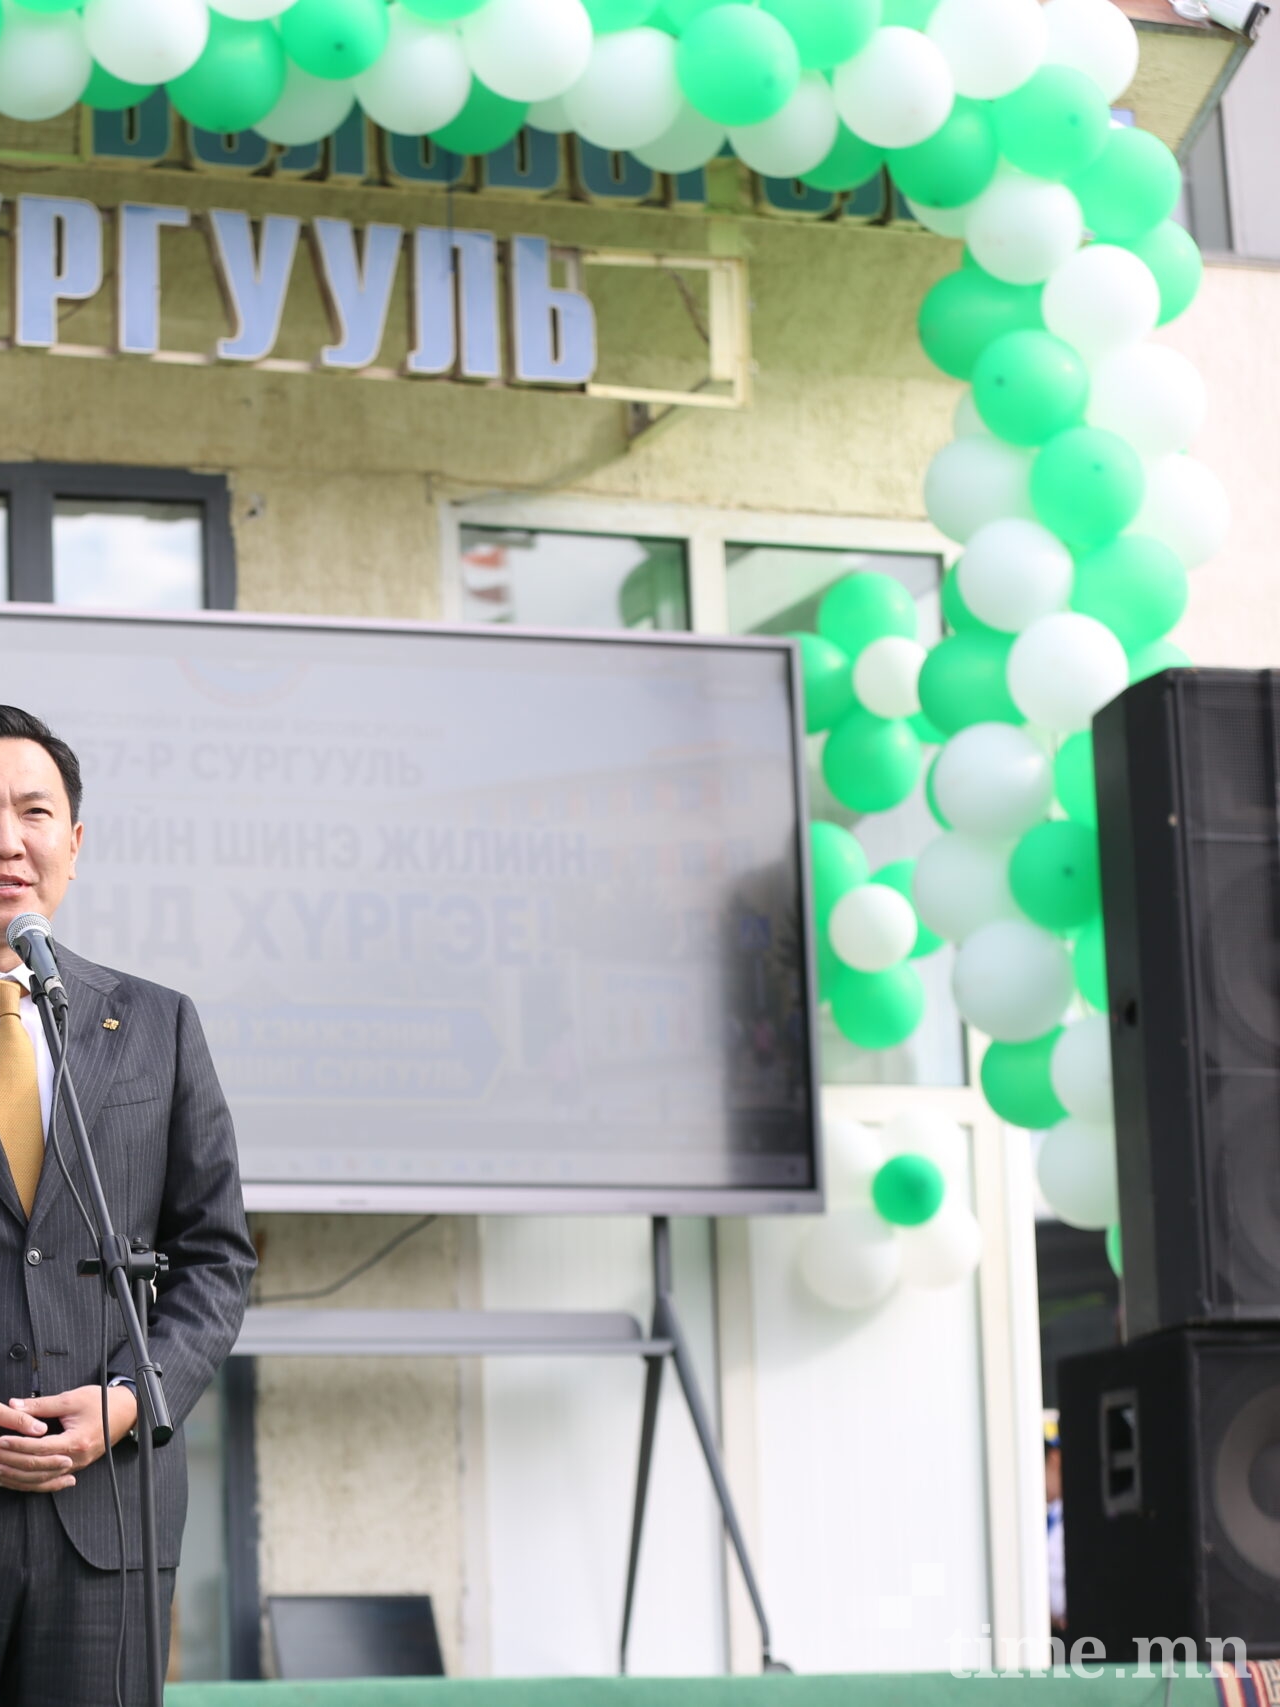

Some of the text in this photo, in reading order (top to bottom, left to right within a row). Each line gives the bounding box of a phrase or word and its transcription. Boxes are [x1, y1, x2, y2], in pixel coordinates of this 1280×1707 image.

[189, 741, 424, 788] СУРГУУЛЬ
[211, 818, 362, 871] ШИНЭ
[375, 812, 588, 877] ЖИЛИЙН
[224, 886, 558, 967] ХҮРГЭЕ!
